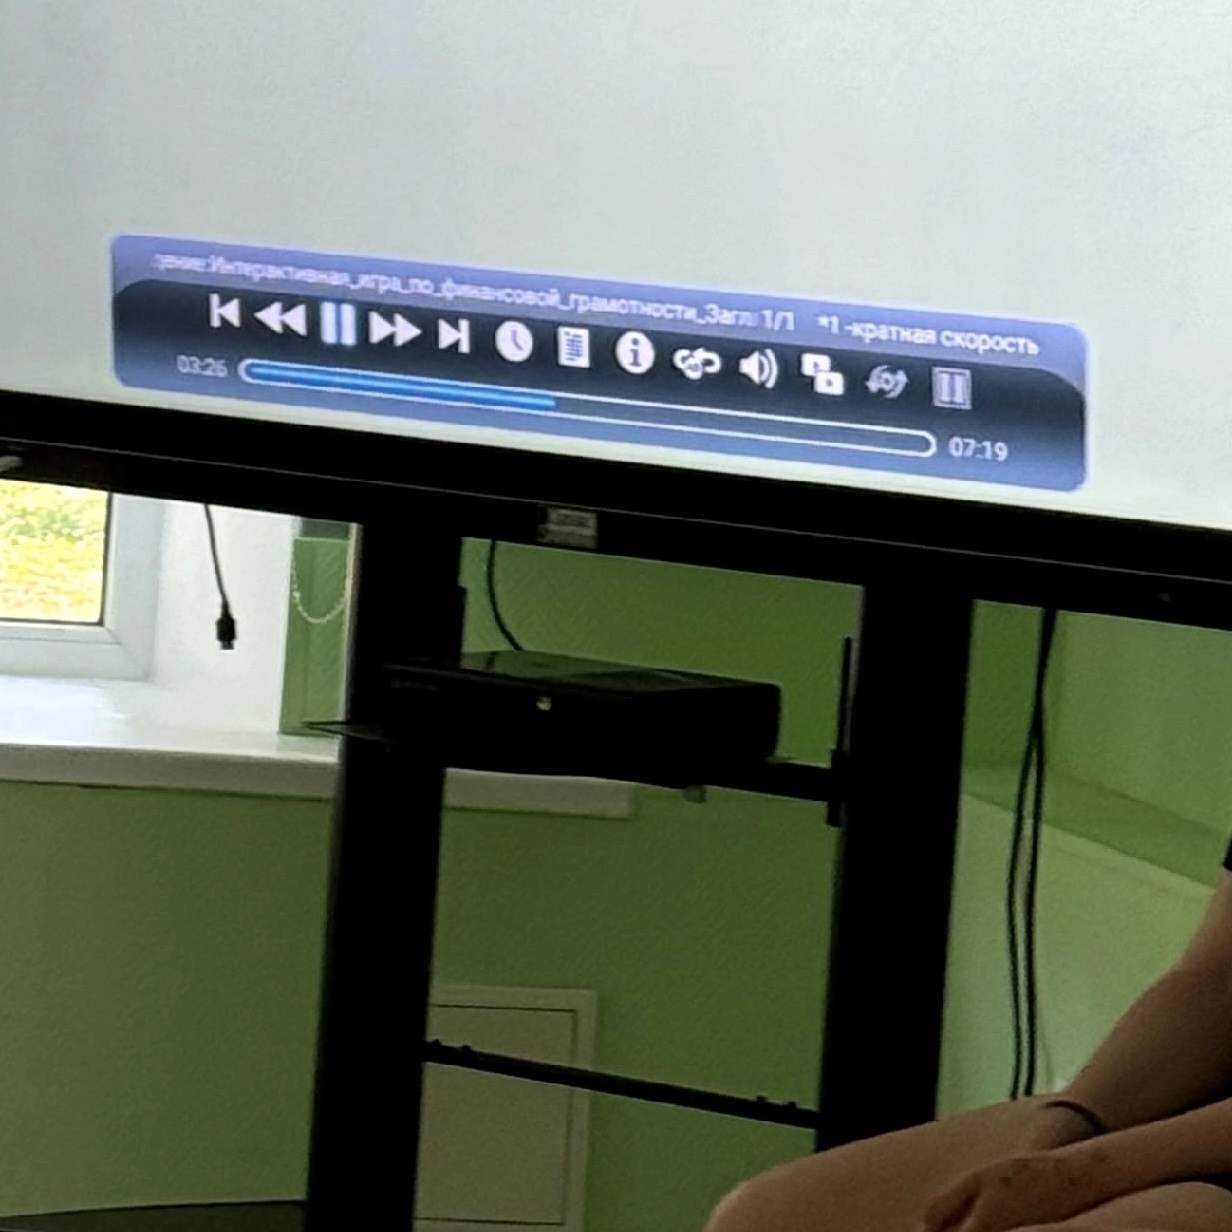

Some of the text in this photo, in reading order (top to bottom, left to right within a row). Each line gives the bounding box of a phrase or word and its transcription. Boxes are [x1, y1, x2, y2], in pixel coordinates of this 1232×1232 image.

[939, 329, 1041, 356] скорость
[175, 354, 228, 378] 03:26
[948, 435, 1009, 462] 07:19
